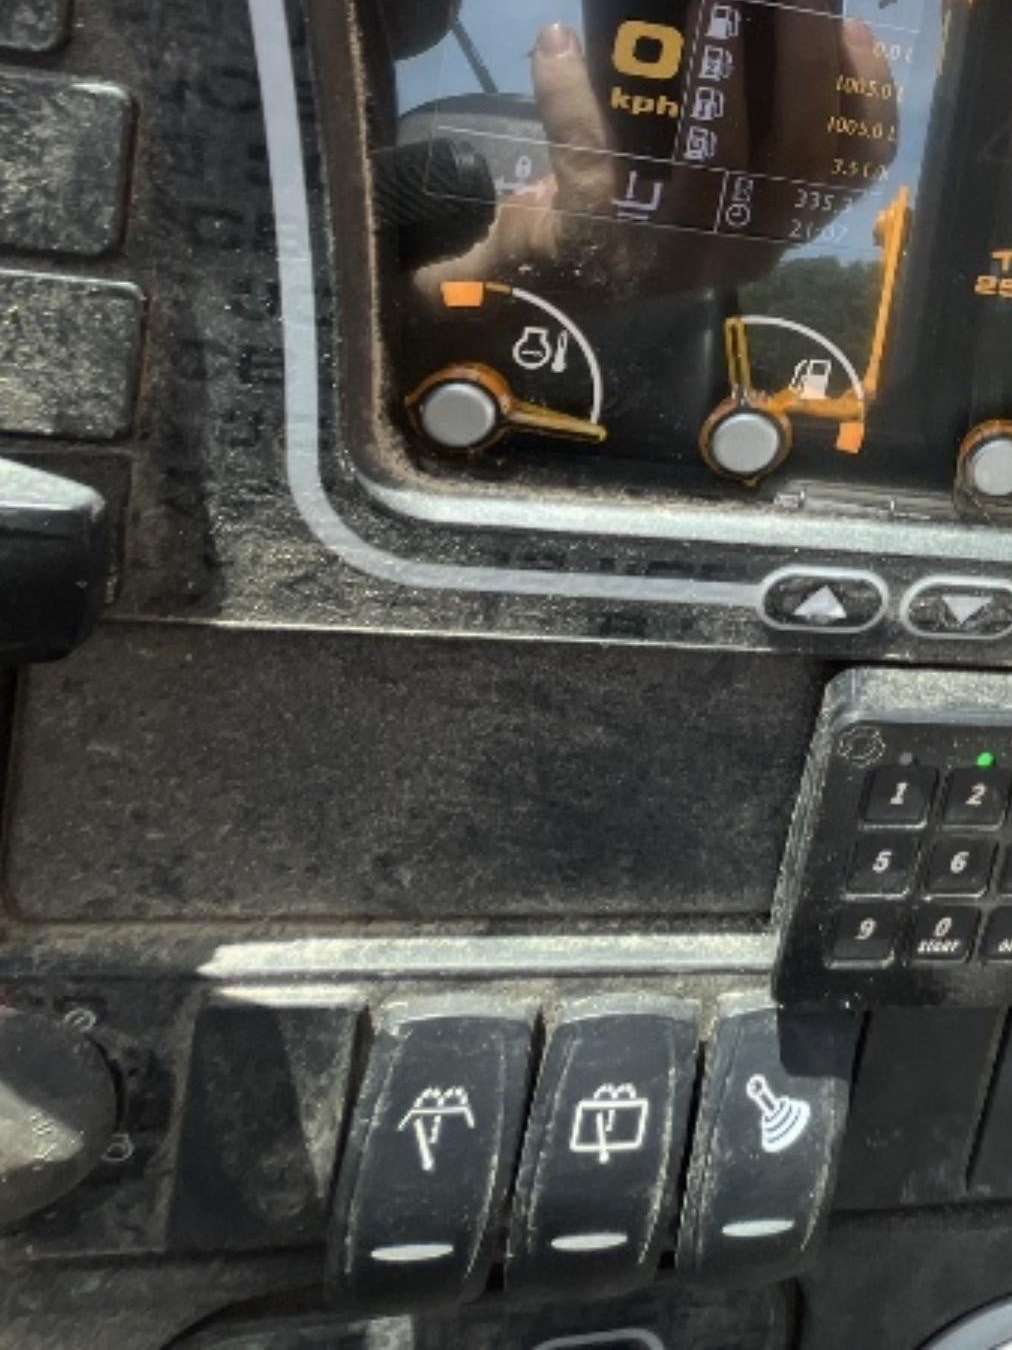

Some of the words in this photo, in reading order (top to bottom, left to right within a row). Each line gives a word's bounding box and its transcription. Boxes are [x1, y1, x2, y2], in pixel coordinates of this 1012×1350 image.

[611, 21, 684, 79] 0
[611, 87, 679, 118] kph
[889, 782, 908, 805] 1
[965, 783, 987, 806] 2
[873, 850, 892, 873] 5
[950, 851, 970, 874] 6
[856, 917, 876, 940] 9
[934, 917, 953, 939] 0
